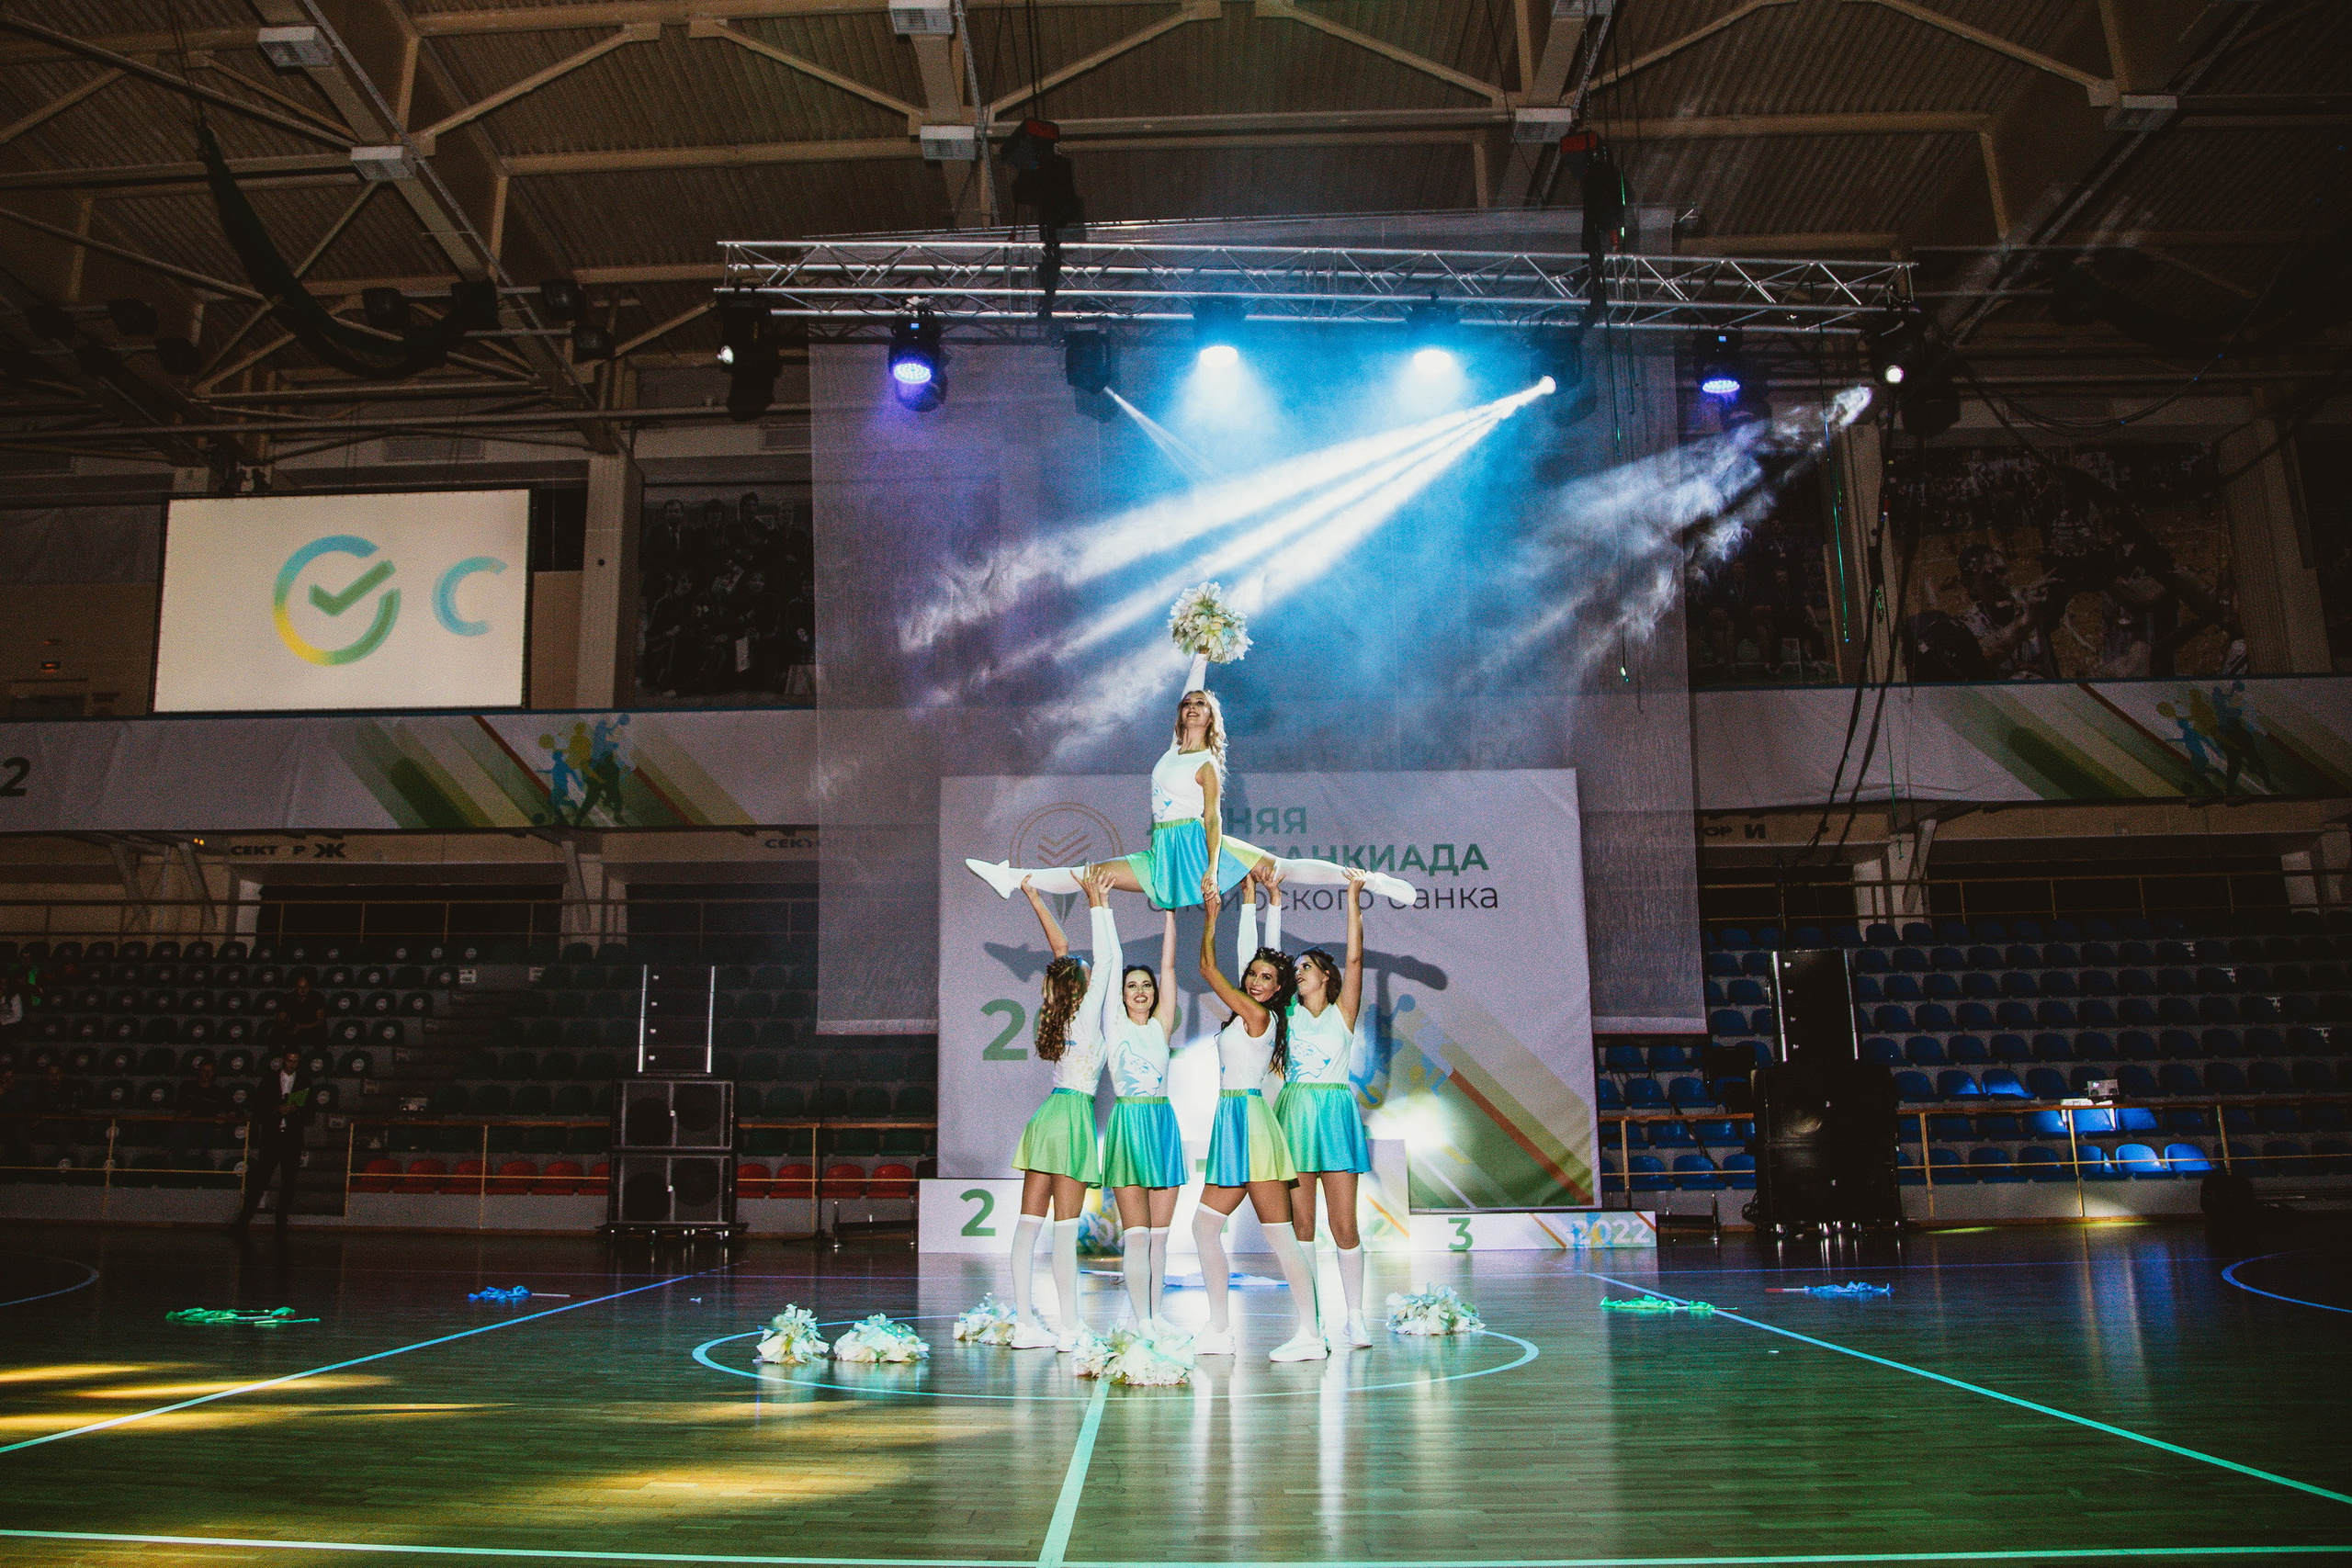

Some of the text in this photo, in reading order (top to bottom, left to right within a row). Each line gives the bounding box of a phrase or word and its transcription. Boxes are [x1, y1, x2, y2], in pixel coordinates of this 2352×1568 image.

[230, 842, 346, 858] СЕКТР Ж
[1263, 843, 1489, 876] АНКИАДА
[960, 1189, 996, 1236] 2
[1448, 1208, 1482, 1251] 3
[1573, 1219, 1651, 1245] 2022
